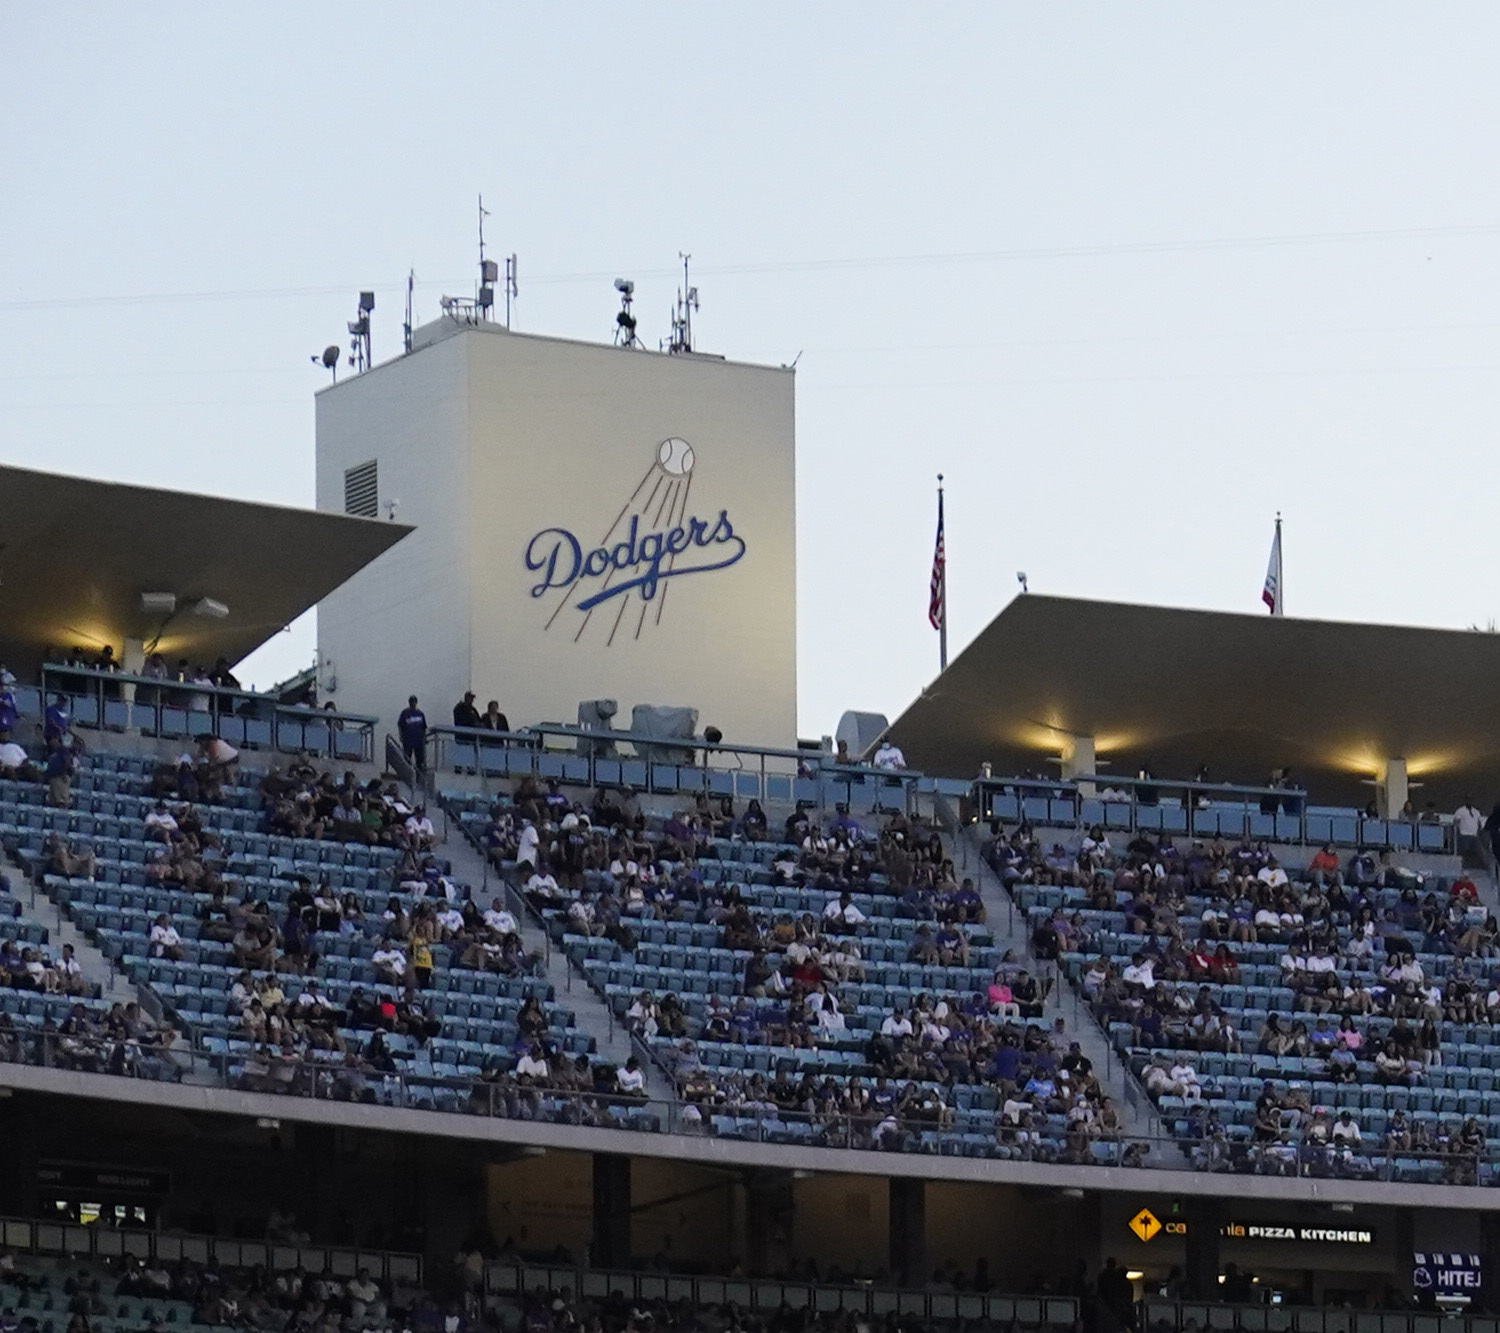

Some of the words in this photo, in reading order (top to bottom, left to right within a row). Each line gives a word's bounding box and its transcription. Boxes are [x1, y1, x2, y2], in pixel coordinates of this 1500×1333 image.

[525, 509, 746, 611] Dodgers
[1249, 1226, 1295, 1238] PIZZA
[1301, 1228, 1371, 1242] KITCHEN
